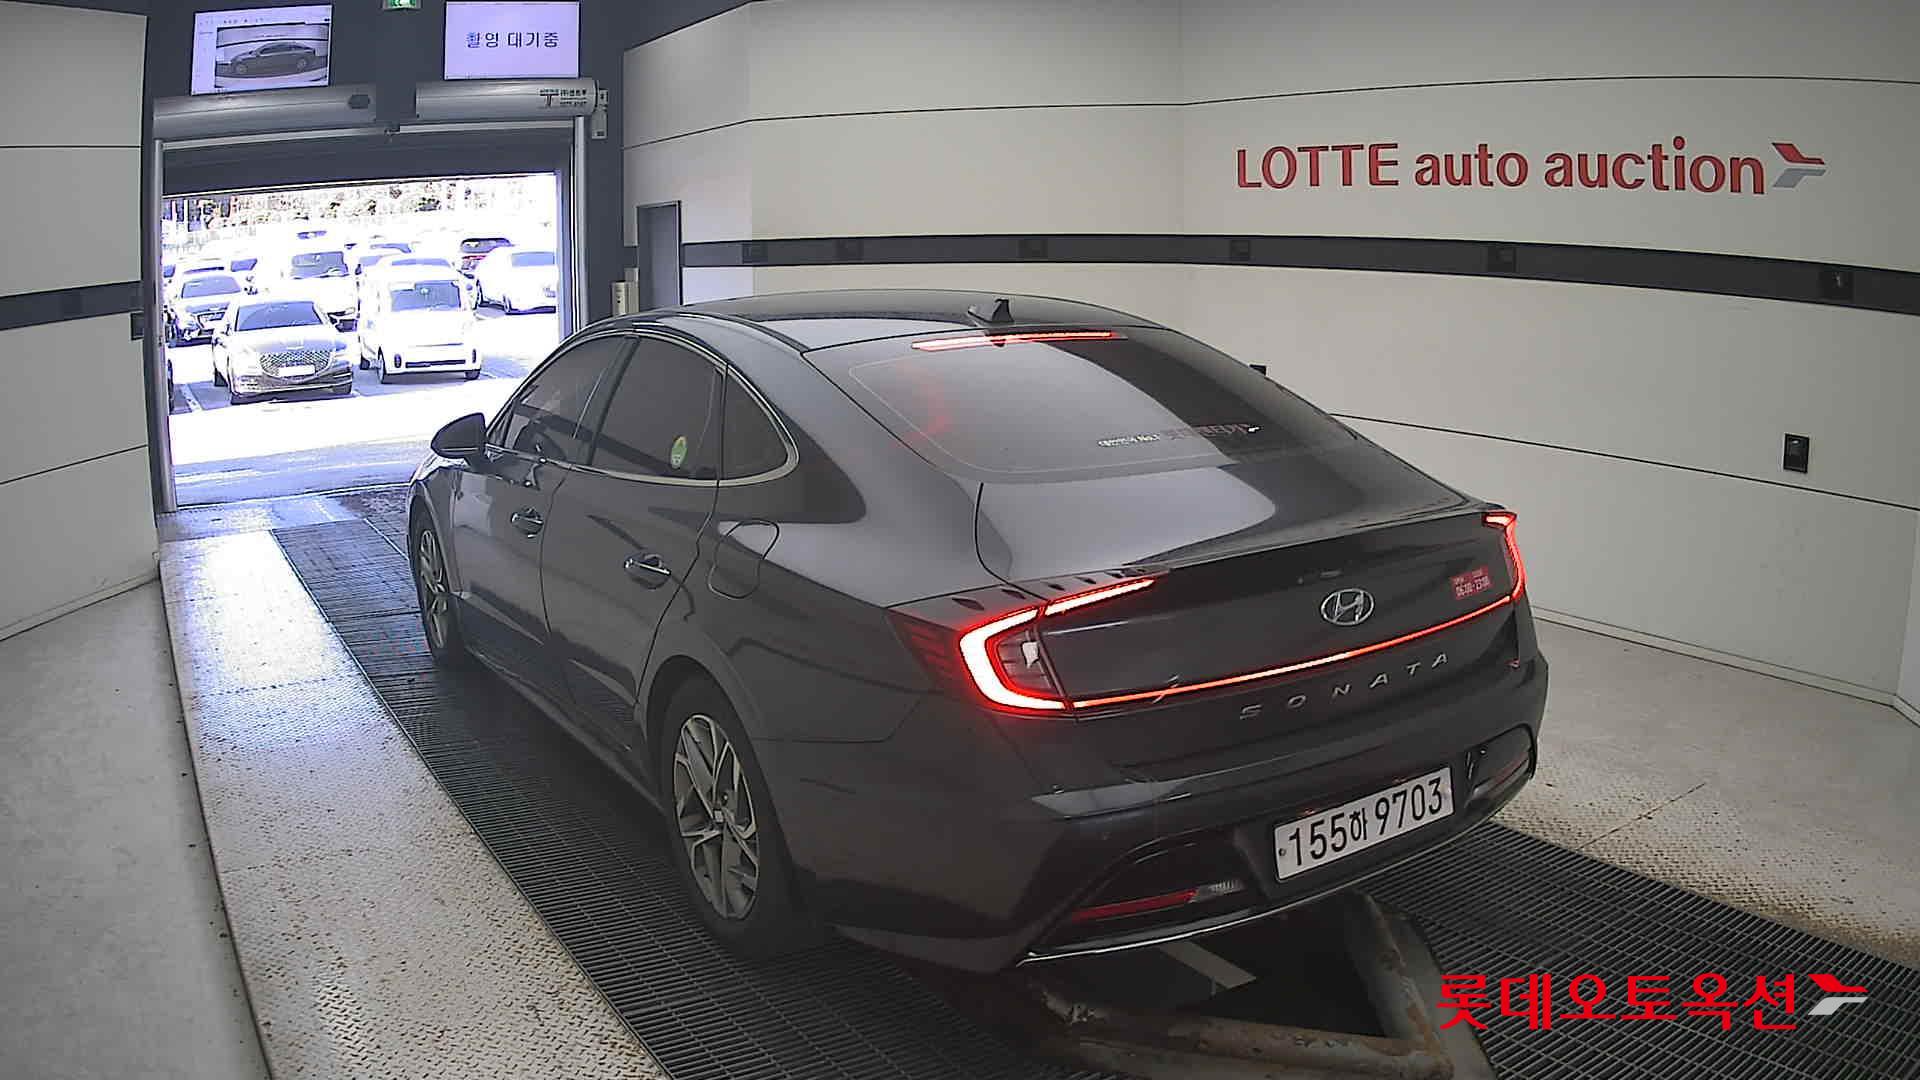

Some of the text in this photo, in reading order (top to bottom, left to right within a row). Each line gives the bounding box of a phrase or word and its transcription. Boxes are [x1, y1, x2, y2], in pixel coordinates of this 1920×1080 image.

[507, 31, 559, 49] 대기중
[1237, 136, 1767, 194] LOTTE auto auction
[1239, 652, 1449, 720] SONATA
[1287, 776, 1443, 867] 155하 9703
